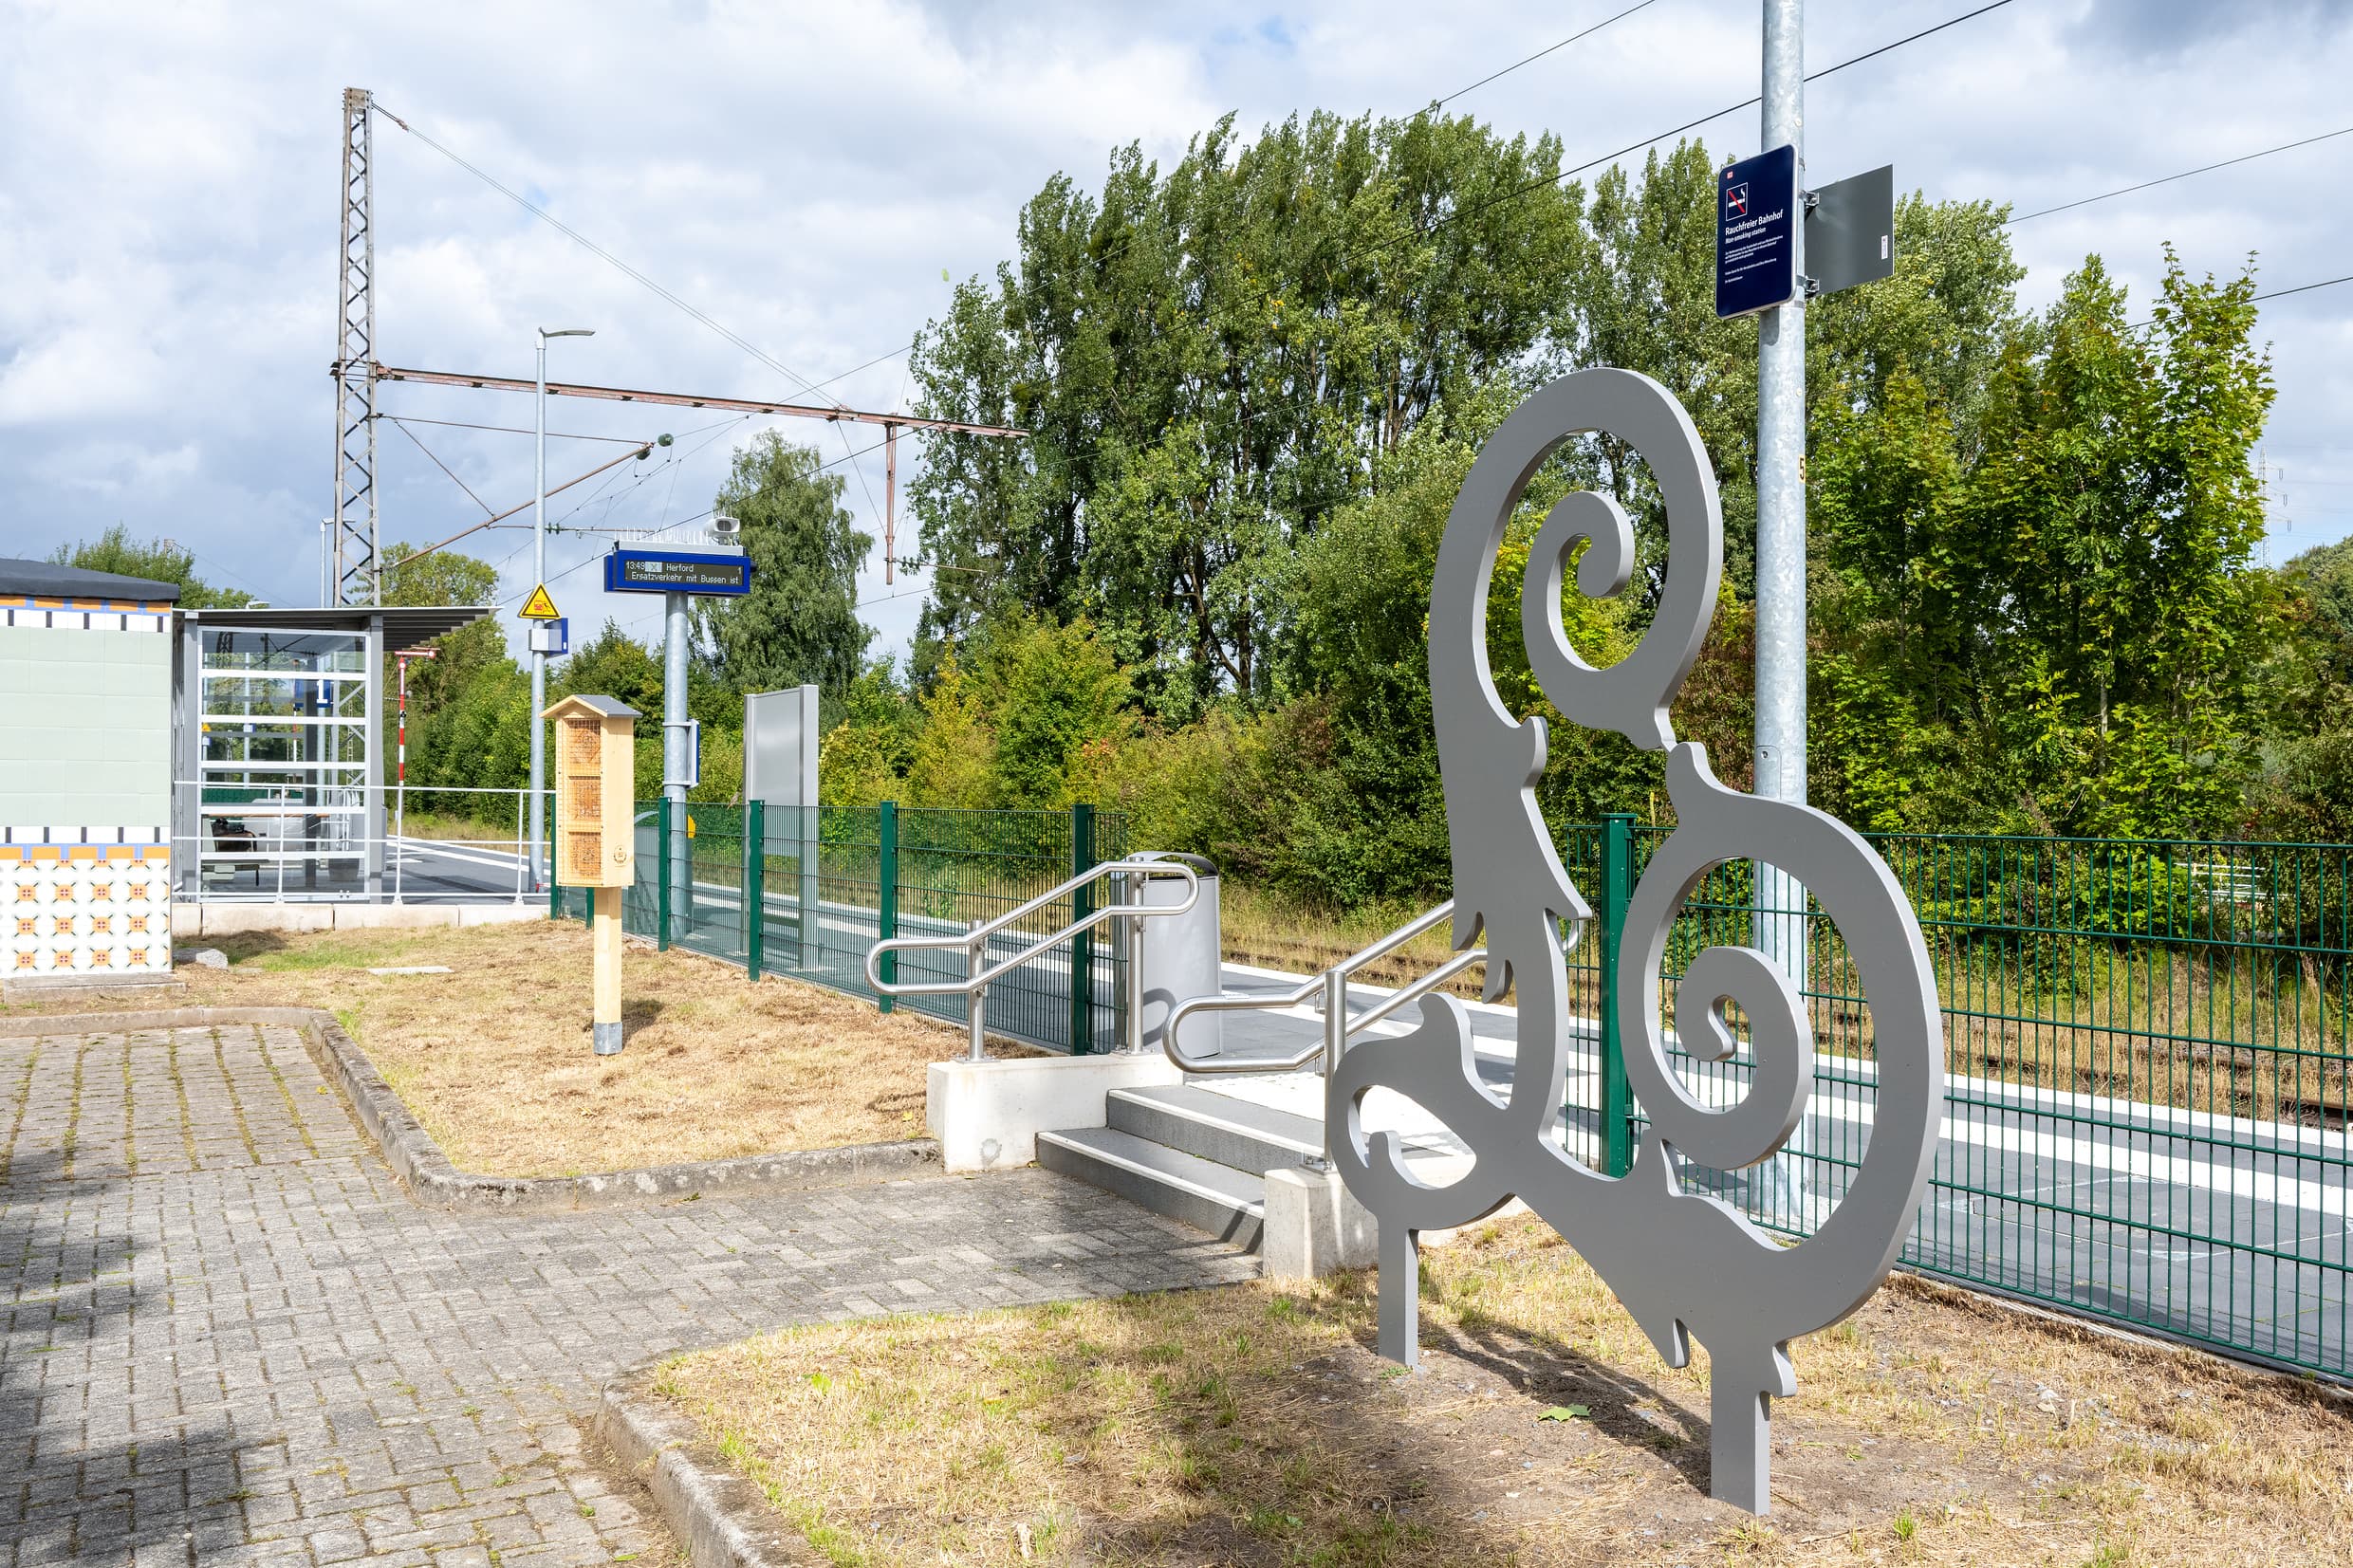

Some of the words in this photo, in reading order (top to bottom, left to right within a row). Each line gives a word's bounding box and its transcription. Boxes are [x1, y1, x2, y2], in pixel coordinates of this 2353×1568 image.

[1725, 219, 1758, 235] Rauchfreier
[1758, 209, 1784, 225] Bahnhof
[1751, 228, 1767, 236] station
[1800, 457, 1805, 480] 5
[666, 563, 694, 573] Herford
[631, 571, 683, 581] Ersatzverkehr
[686, 574, 697, 582] mit
[700, 574, 727, 584] Bussen
[730, 576, 739, 584] ist
[317, 679, 328, 704] 1
